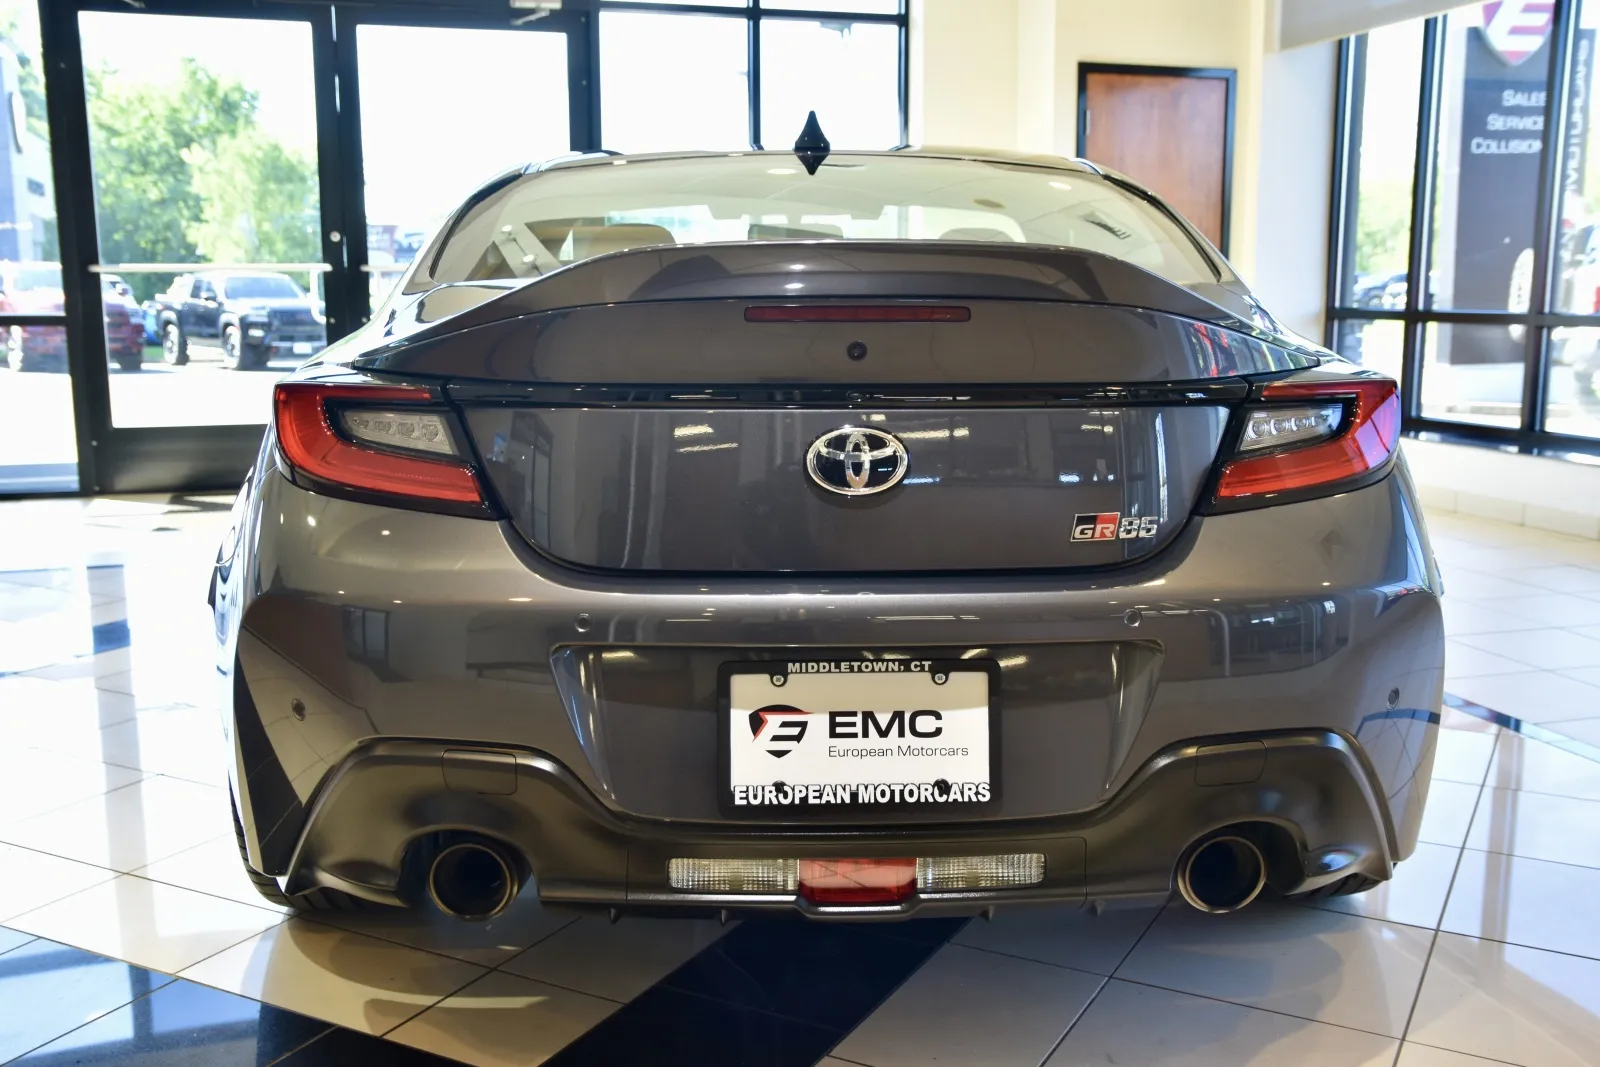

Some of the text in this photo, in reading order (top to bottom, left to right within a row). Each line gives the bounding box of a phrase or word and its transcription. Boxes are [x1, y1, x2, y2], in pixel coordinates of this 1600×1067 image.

[787, 660, 932, 673] MIDDLETOWN, CT
[828, 709, 943, 739] EMC
[828, 744, 969, 759] European Motorcars
[733, 782, 991, 805] EUROPEAN MOTORCARS
